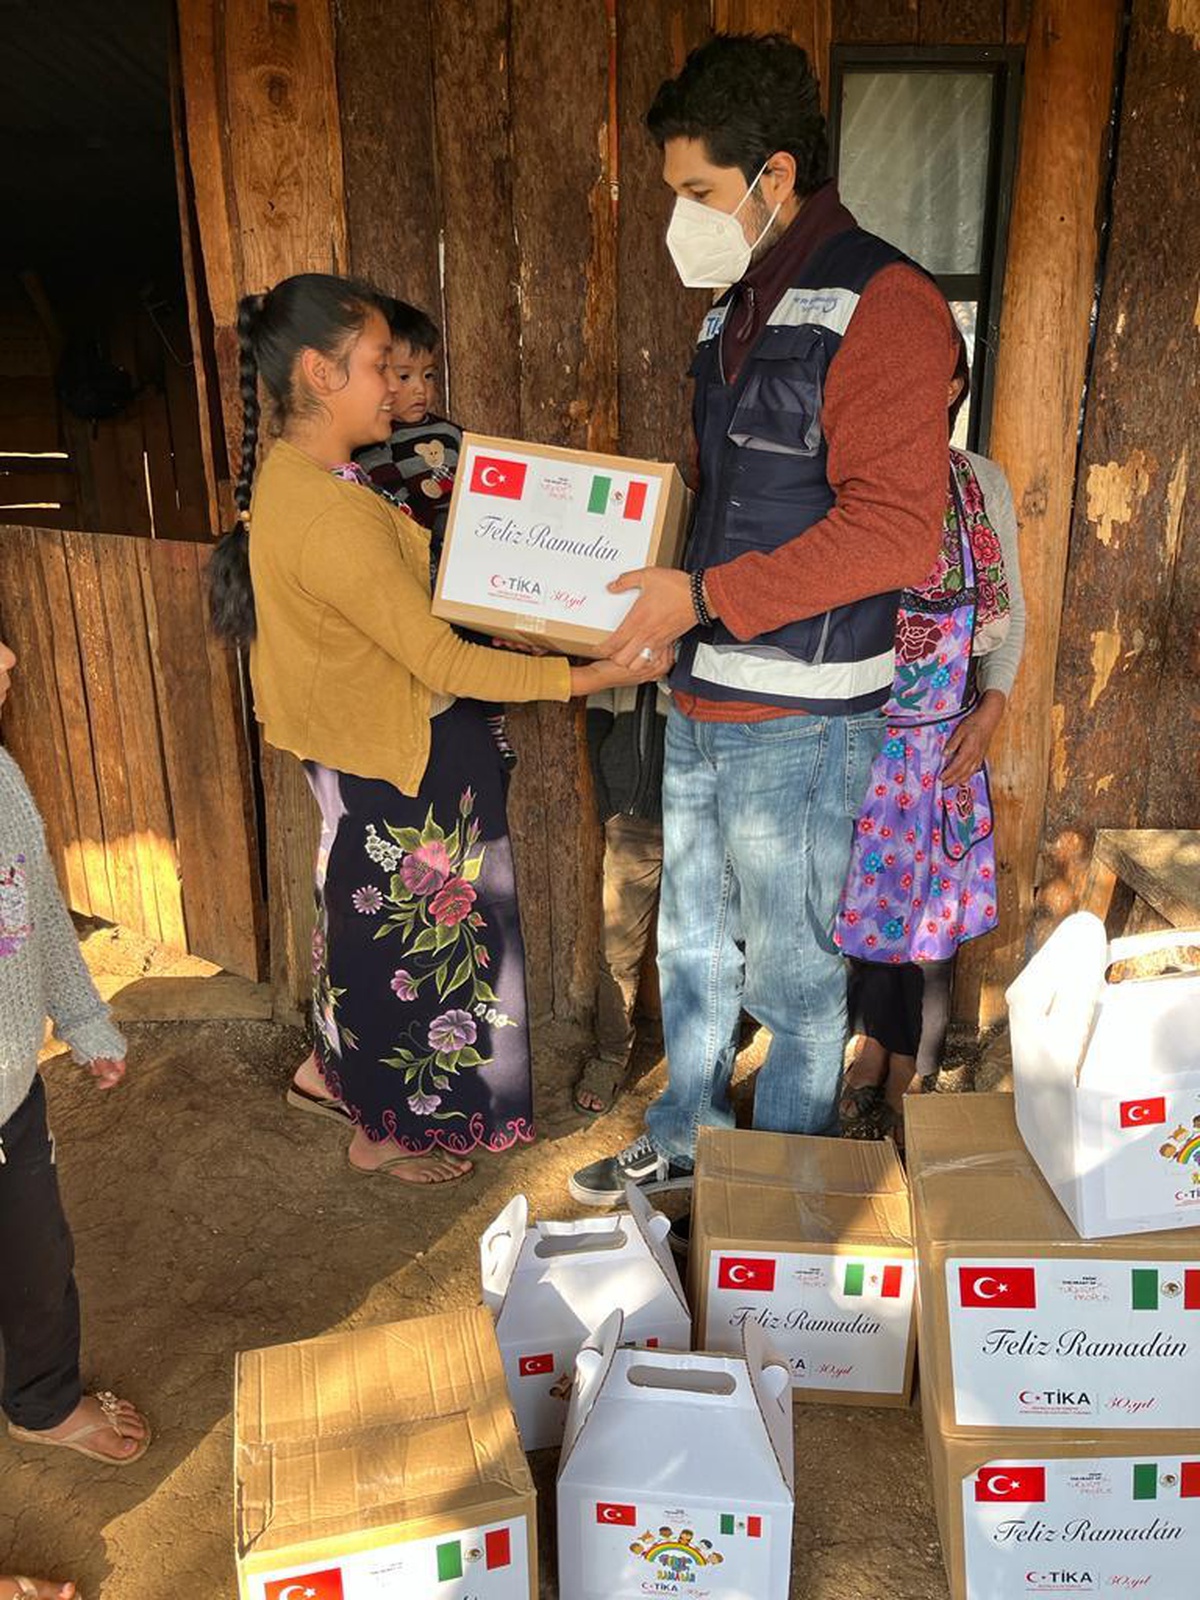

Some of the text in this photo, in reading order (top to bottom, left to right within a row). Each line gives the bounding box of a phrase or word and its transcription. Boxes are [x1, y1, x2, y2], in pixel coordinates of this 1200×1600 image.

[474, 514, 622, 562] Feliz Ramadán
[729, 1306, 882, 1335] Fliz Ramadán
[982, 1328, 1188, 1358] Feliz Ramadán
[1043, 1388, 1091, 1405] TİKA
[993, 1517, 1184, 1543] Feliz Ramadán
[1049, 1569, 1093, 1583] TİKA
